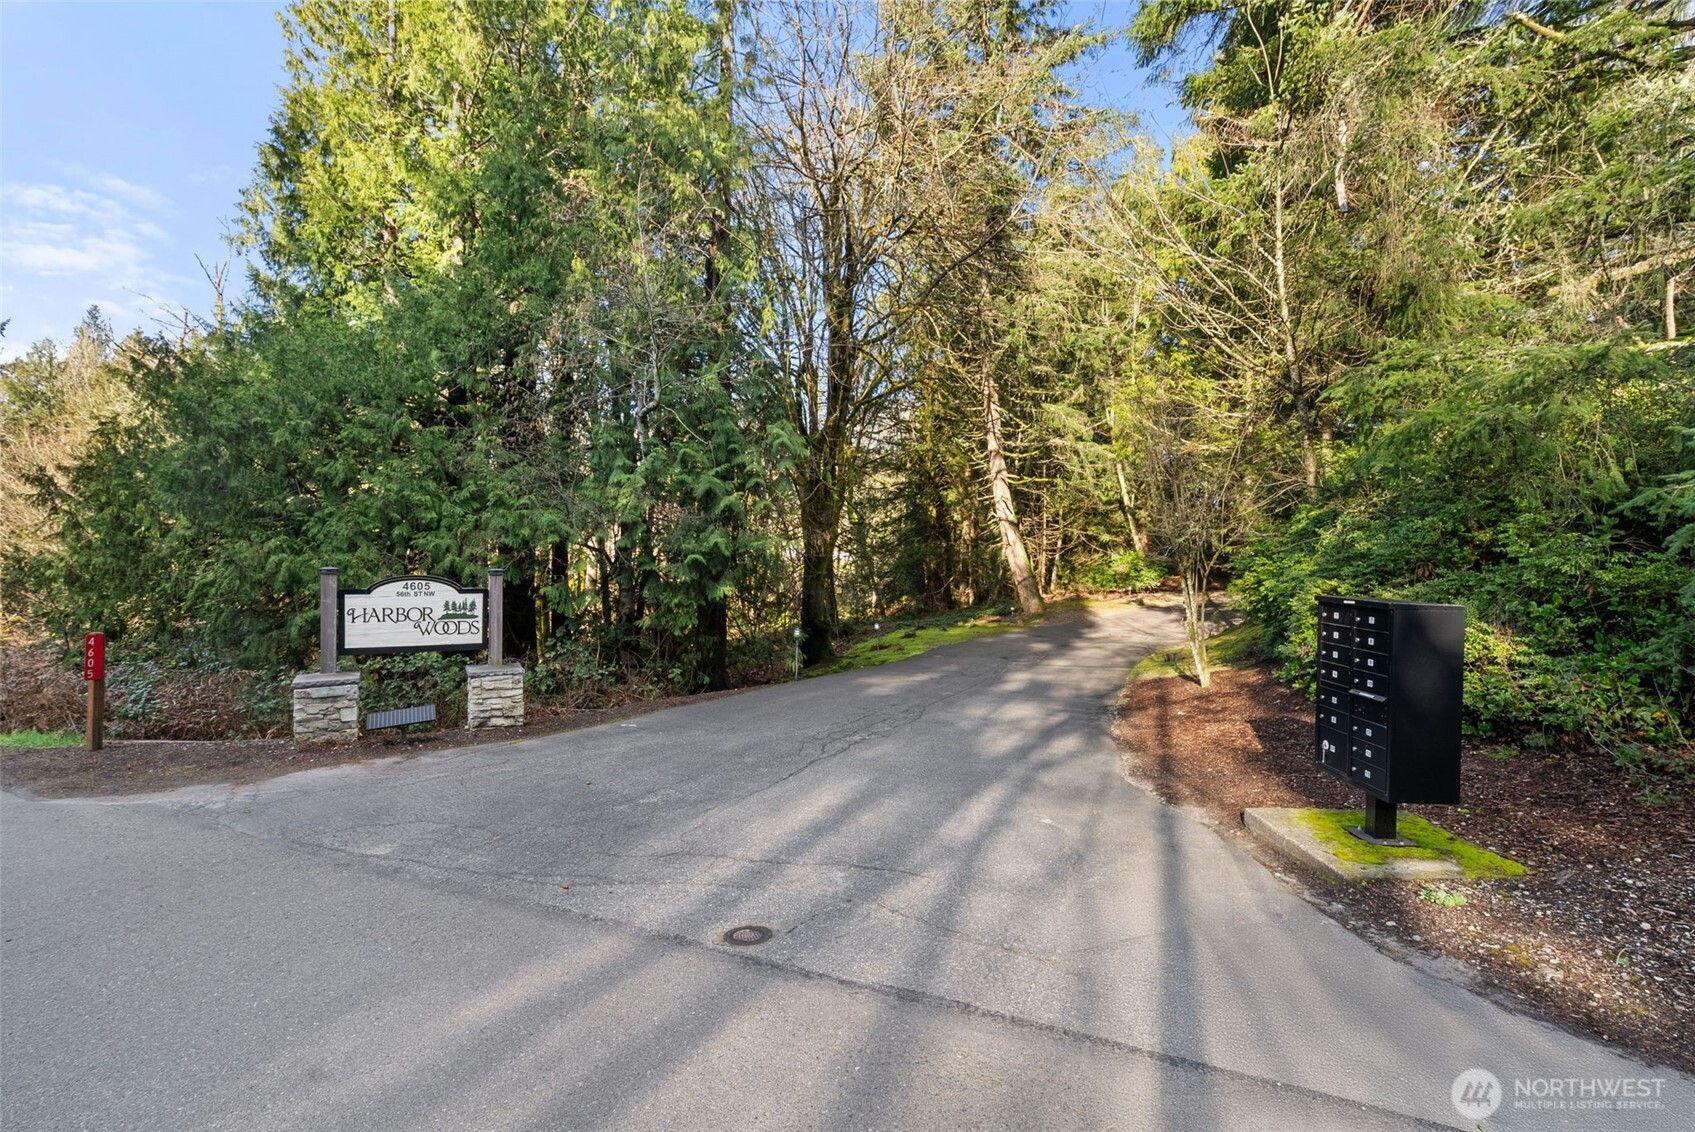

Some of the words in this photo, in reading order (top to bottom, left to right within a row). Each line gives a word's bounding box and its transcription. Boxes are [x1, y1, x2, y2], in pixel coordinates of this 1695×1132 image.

[402, 581, 431, 591] 4605
[346, 606, 436, 624] HARBOR
[413, 620, 480, 636] WOODS
[87, 637, 95, 679] 4605
